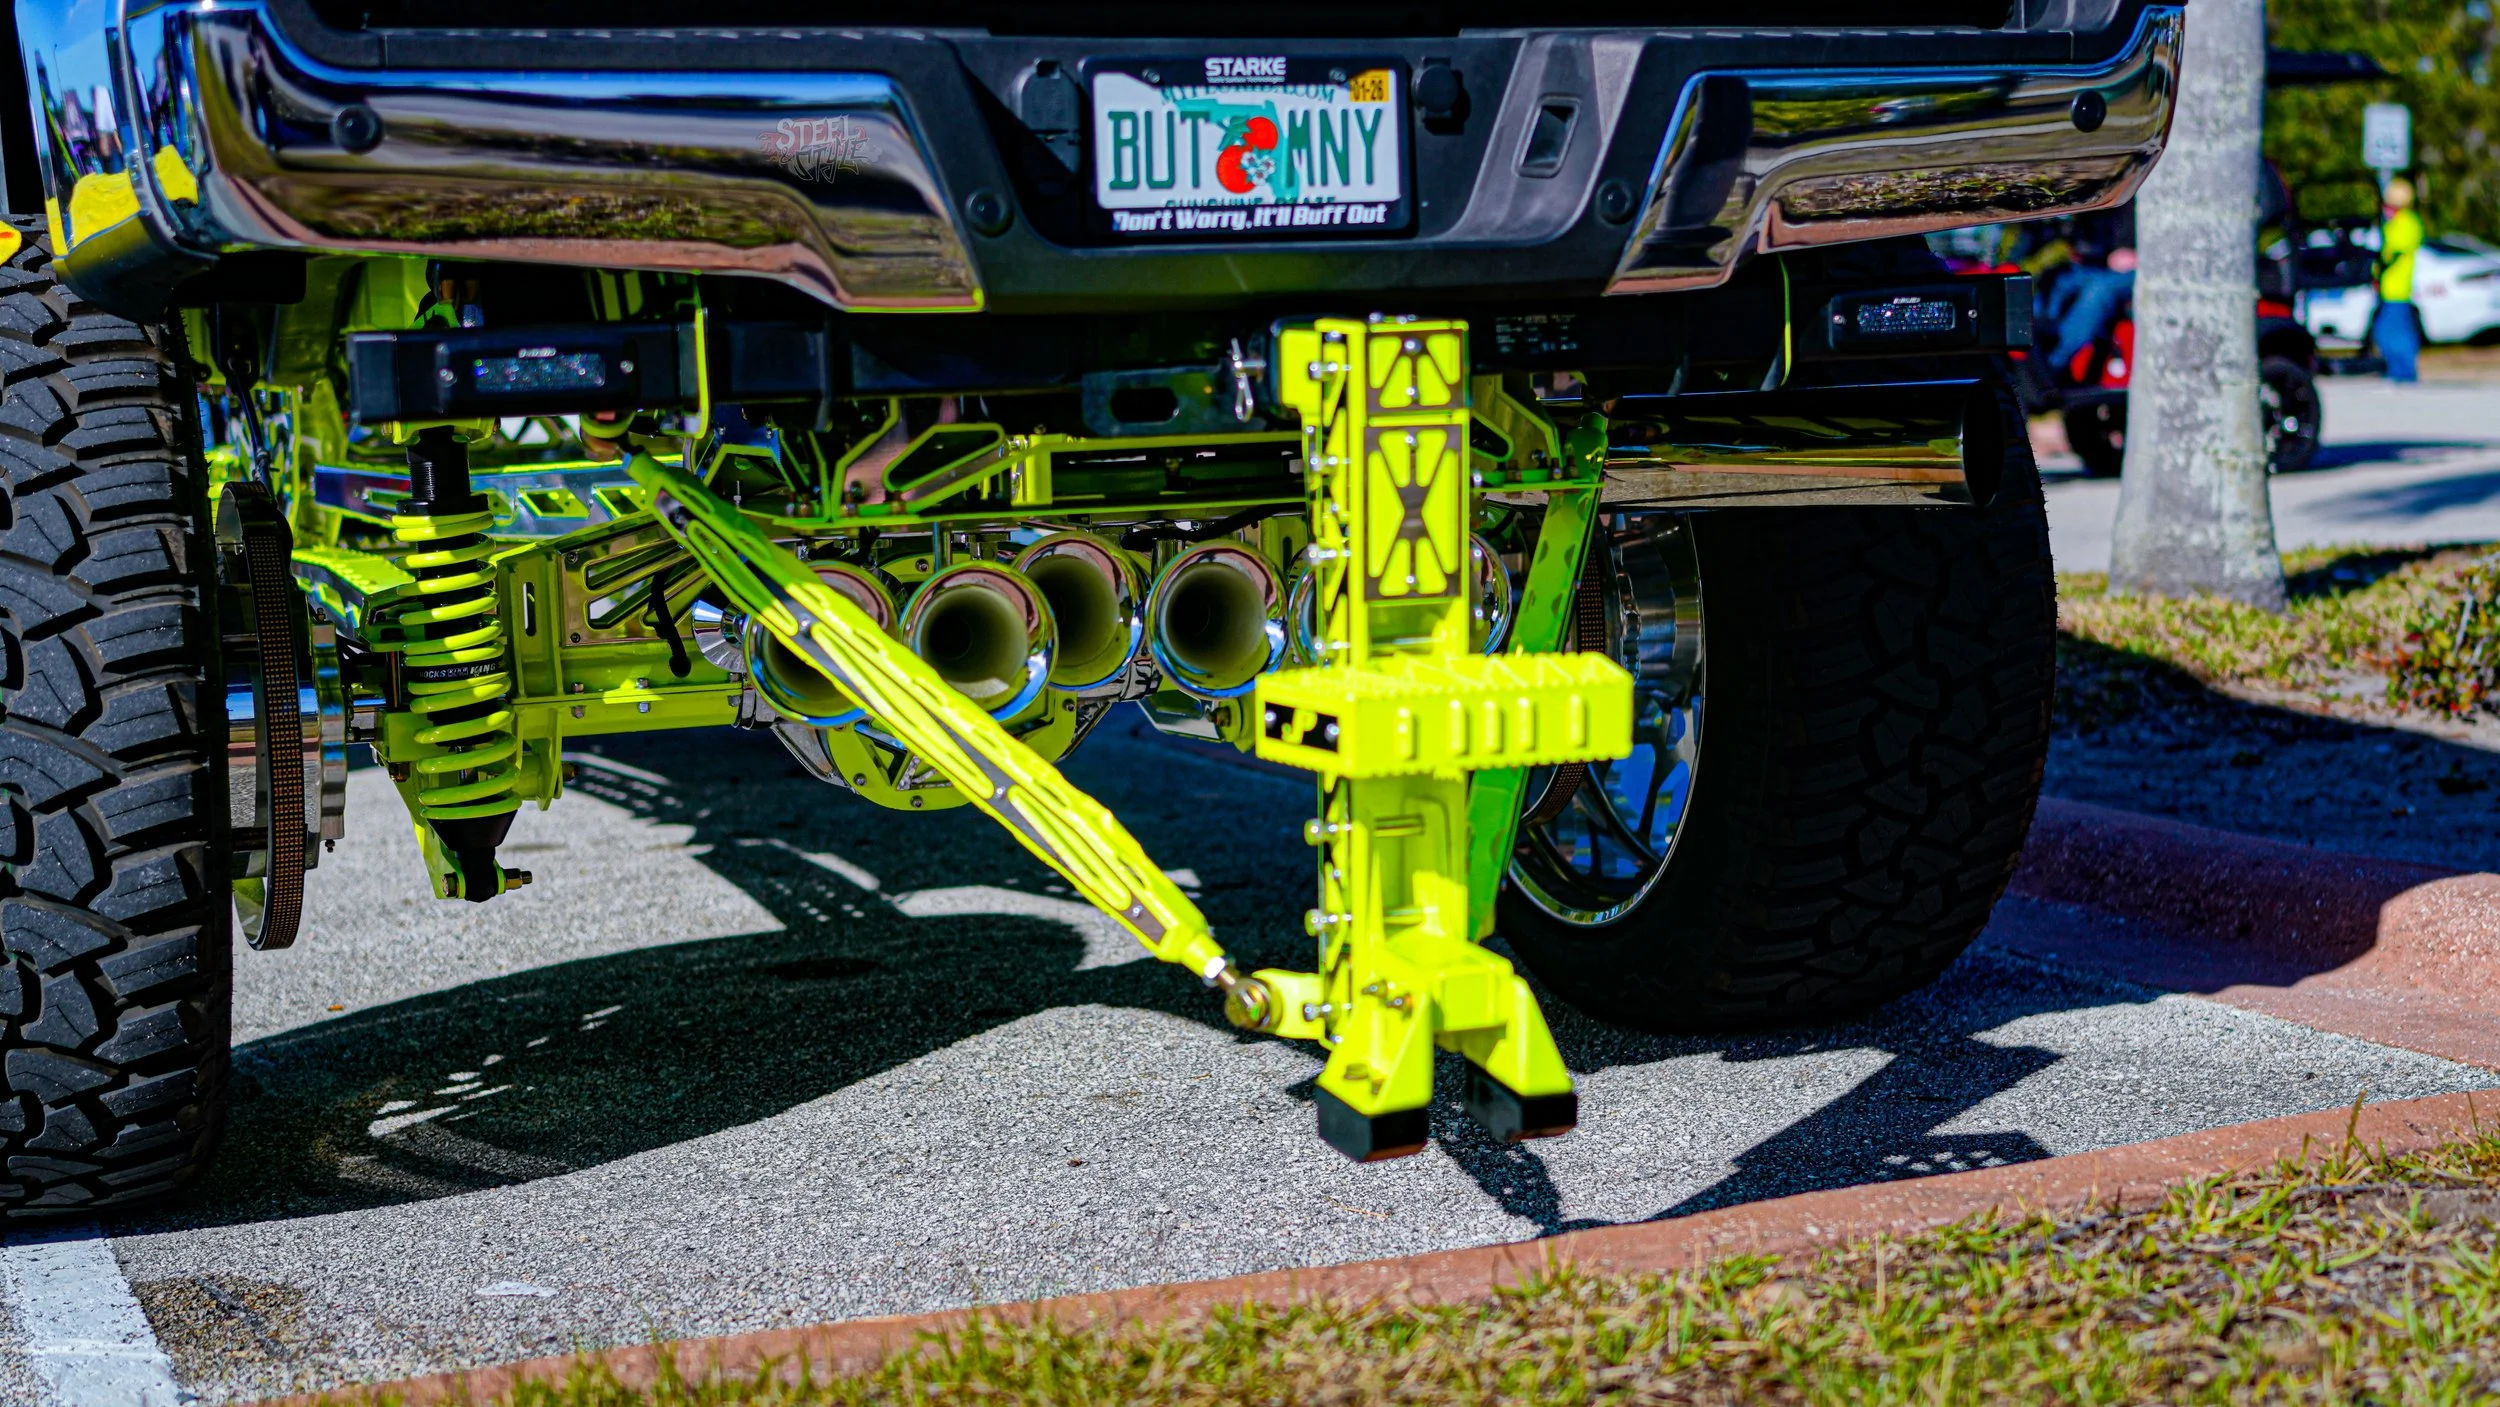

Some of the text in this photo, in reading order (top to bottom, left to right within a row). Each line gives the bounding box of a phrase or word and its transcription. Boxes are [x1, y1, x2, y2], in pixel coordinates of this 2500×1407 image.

[1205, 57, 1287, 76] STARKE
[776, 114, 860, 150] STEEL
[1108, 108, 1383, 190] BUT MNY
[1112, 208, 1173, 232] Don't
[1292, 204, 1347, 226] Buff
[1347, 203, 1387, 224] Out
